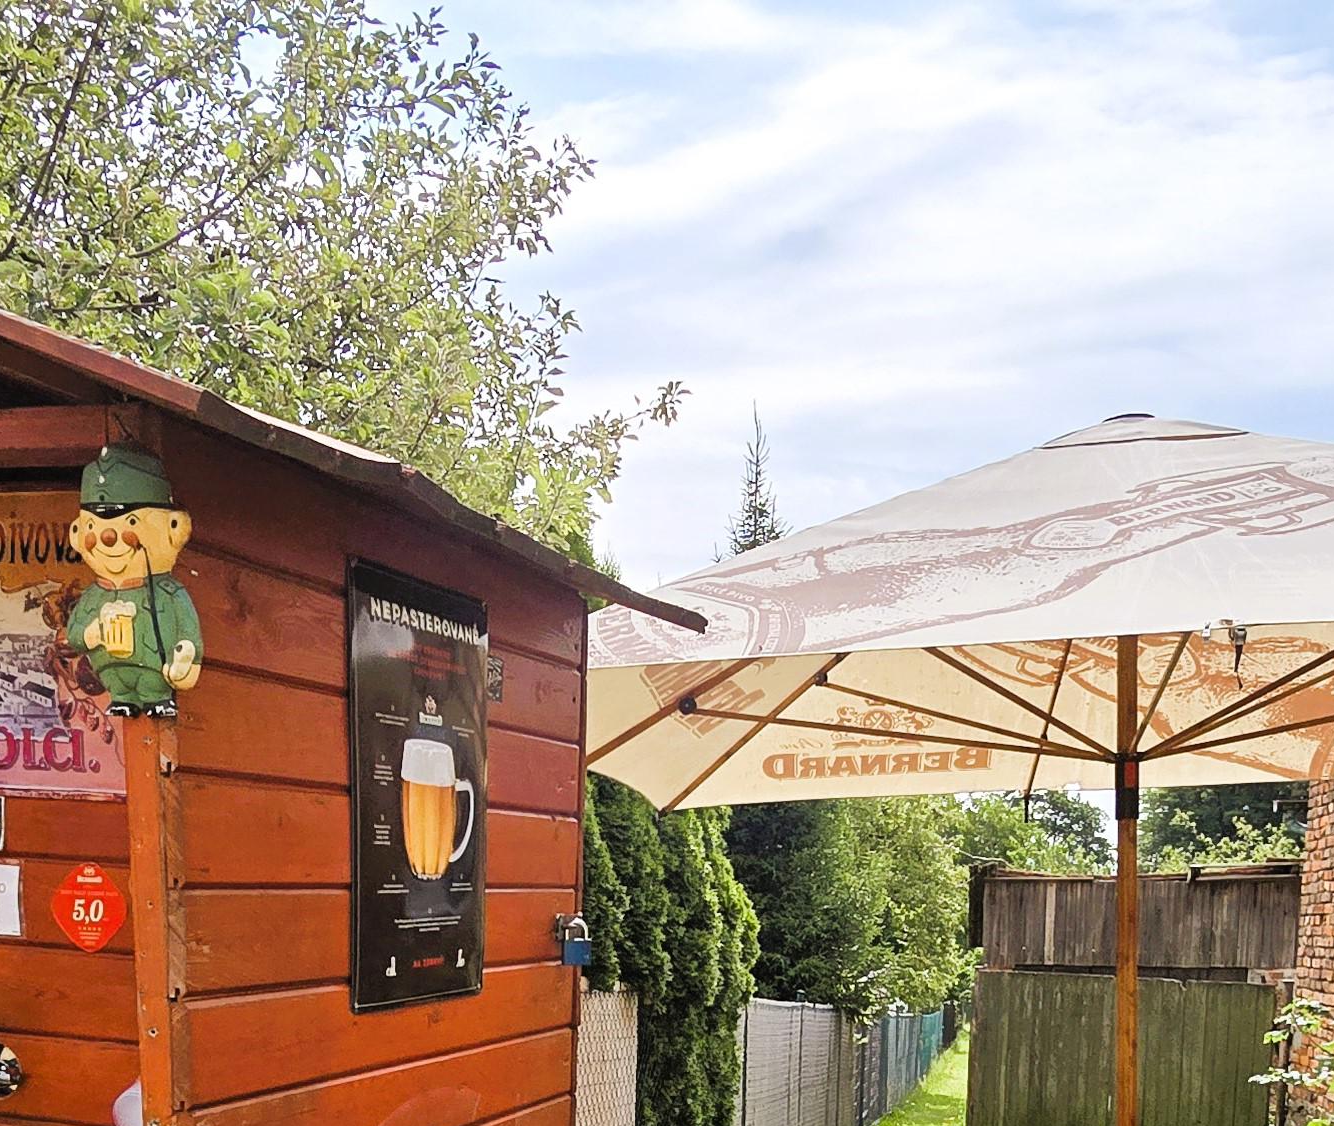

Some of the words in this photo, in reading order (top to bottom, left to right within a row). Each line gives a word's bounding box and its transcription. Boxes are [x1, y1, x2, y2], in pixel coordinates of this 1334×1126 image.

[1107, 490, 1236, 527] BERNARD
[370, 596, 480, 645] NEPASTEROVANÉ
[72, 898, 104, 924] 5,0
